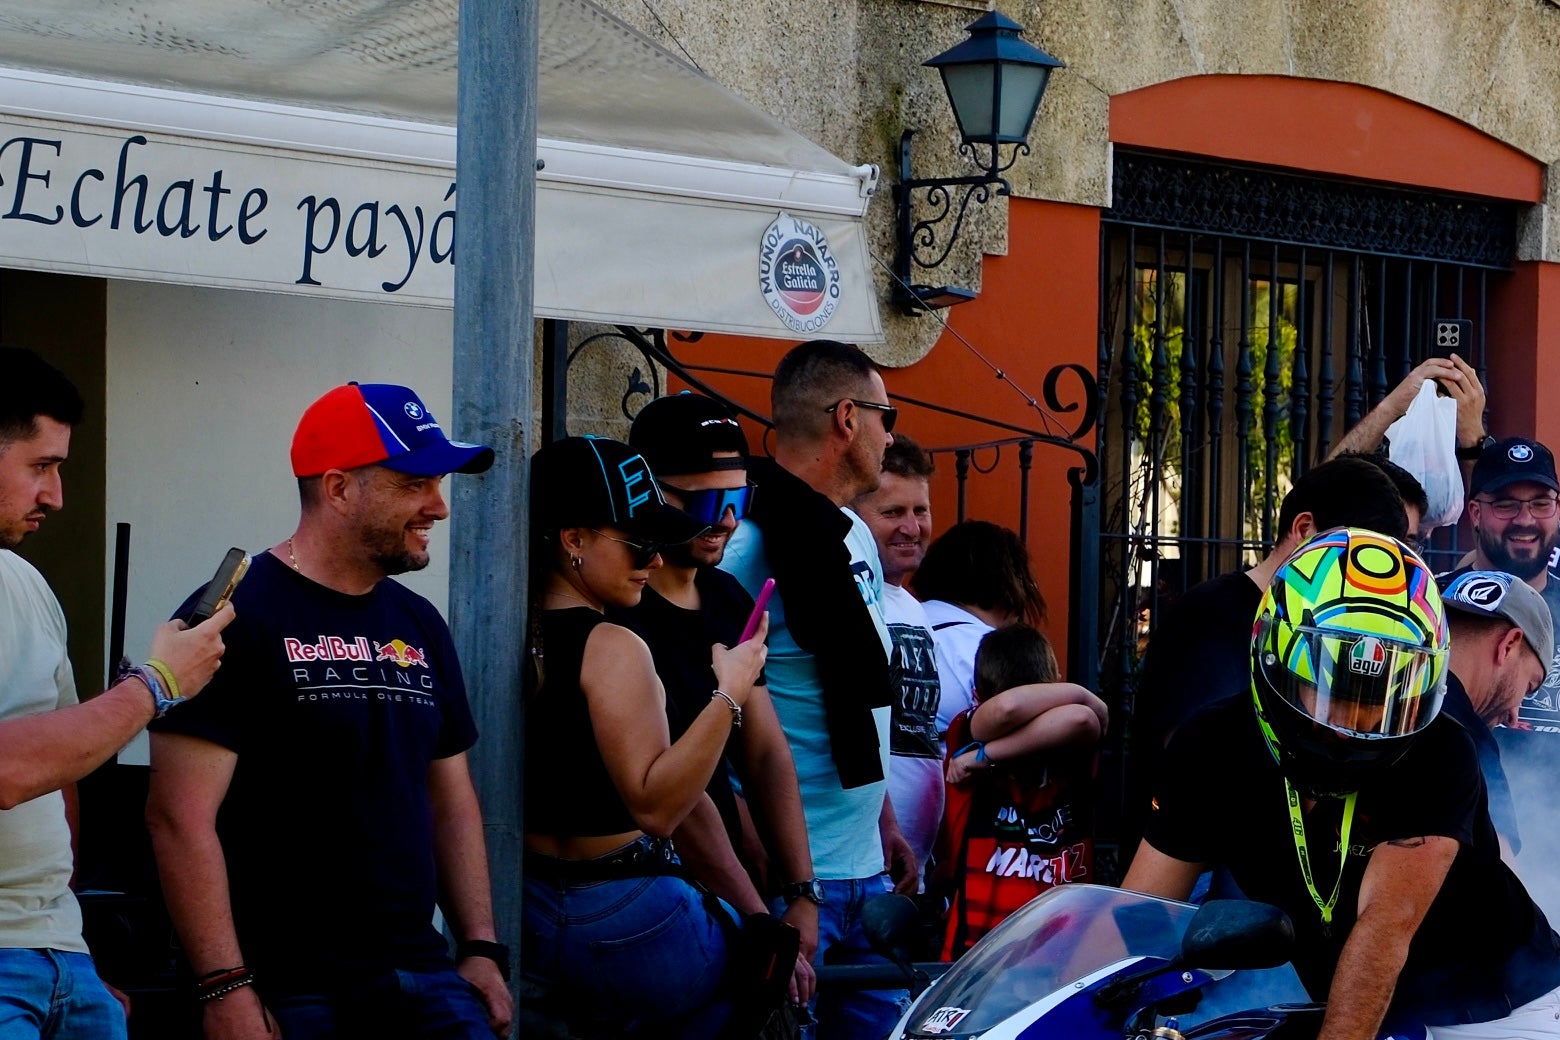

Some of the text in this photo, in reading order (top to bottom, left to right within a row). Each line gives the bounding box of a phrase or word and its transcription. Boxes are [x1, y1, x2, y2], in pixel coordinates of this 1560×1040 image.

[0, 135, 268, 245] Echate
[761, 219, 840, 299] MUÑOZ NAVARRO
[782, 261, 817, 277] Estrella
[784, 275, 818, 290] Galicia
[771, 299, 834, 332] DISTRIBUCIONES
[1353, 658, 1381, 675] agv
[293, 667, 433, 689] RACING
[298, 692, 368, 701] FORMULA
